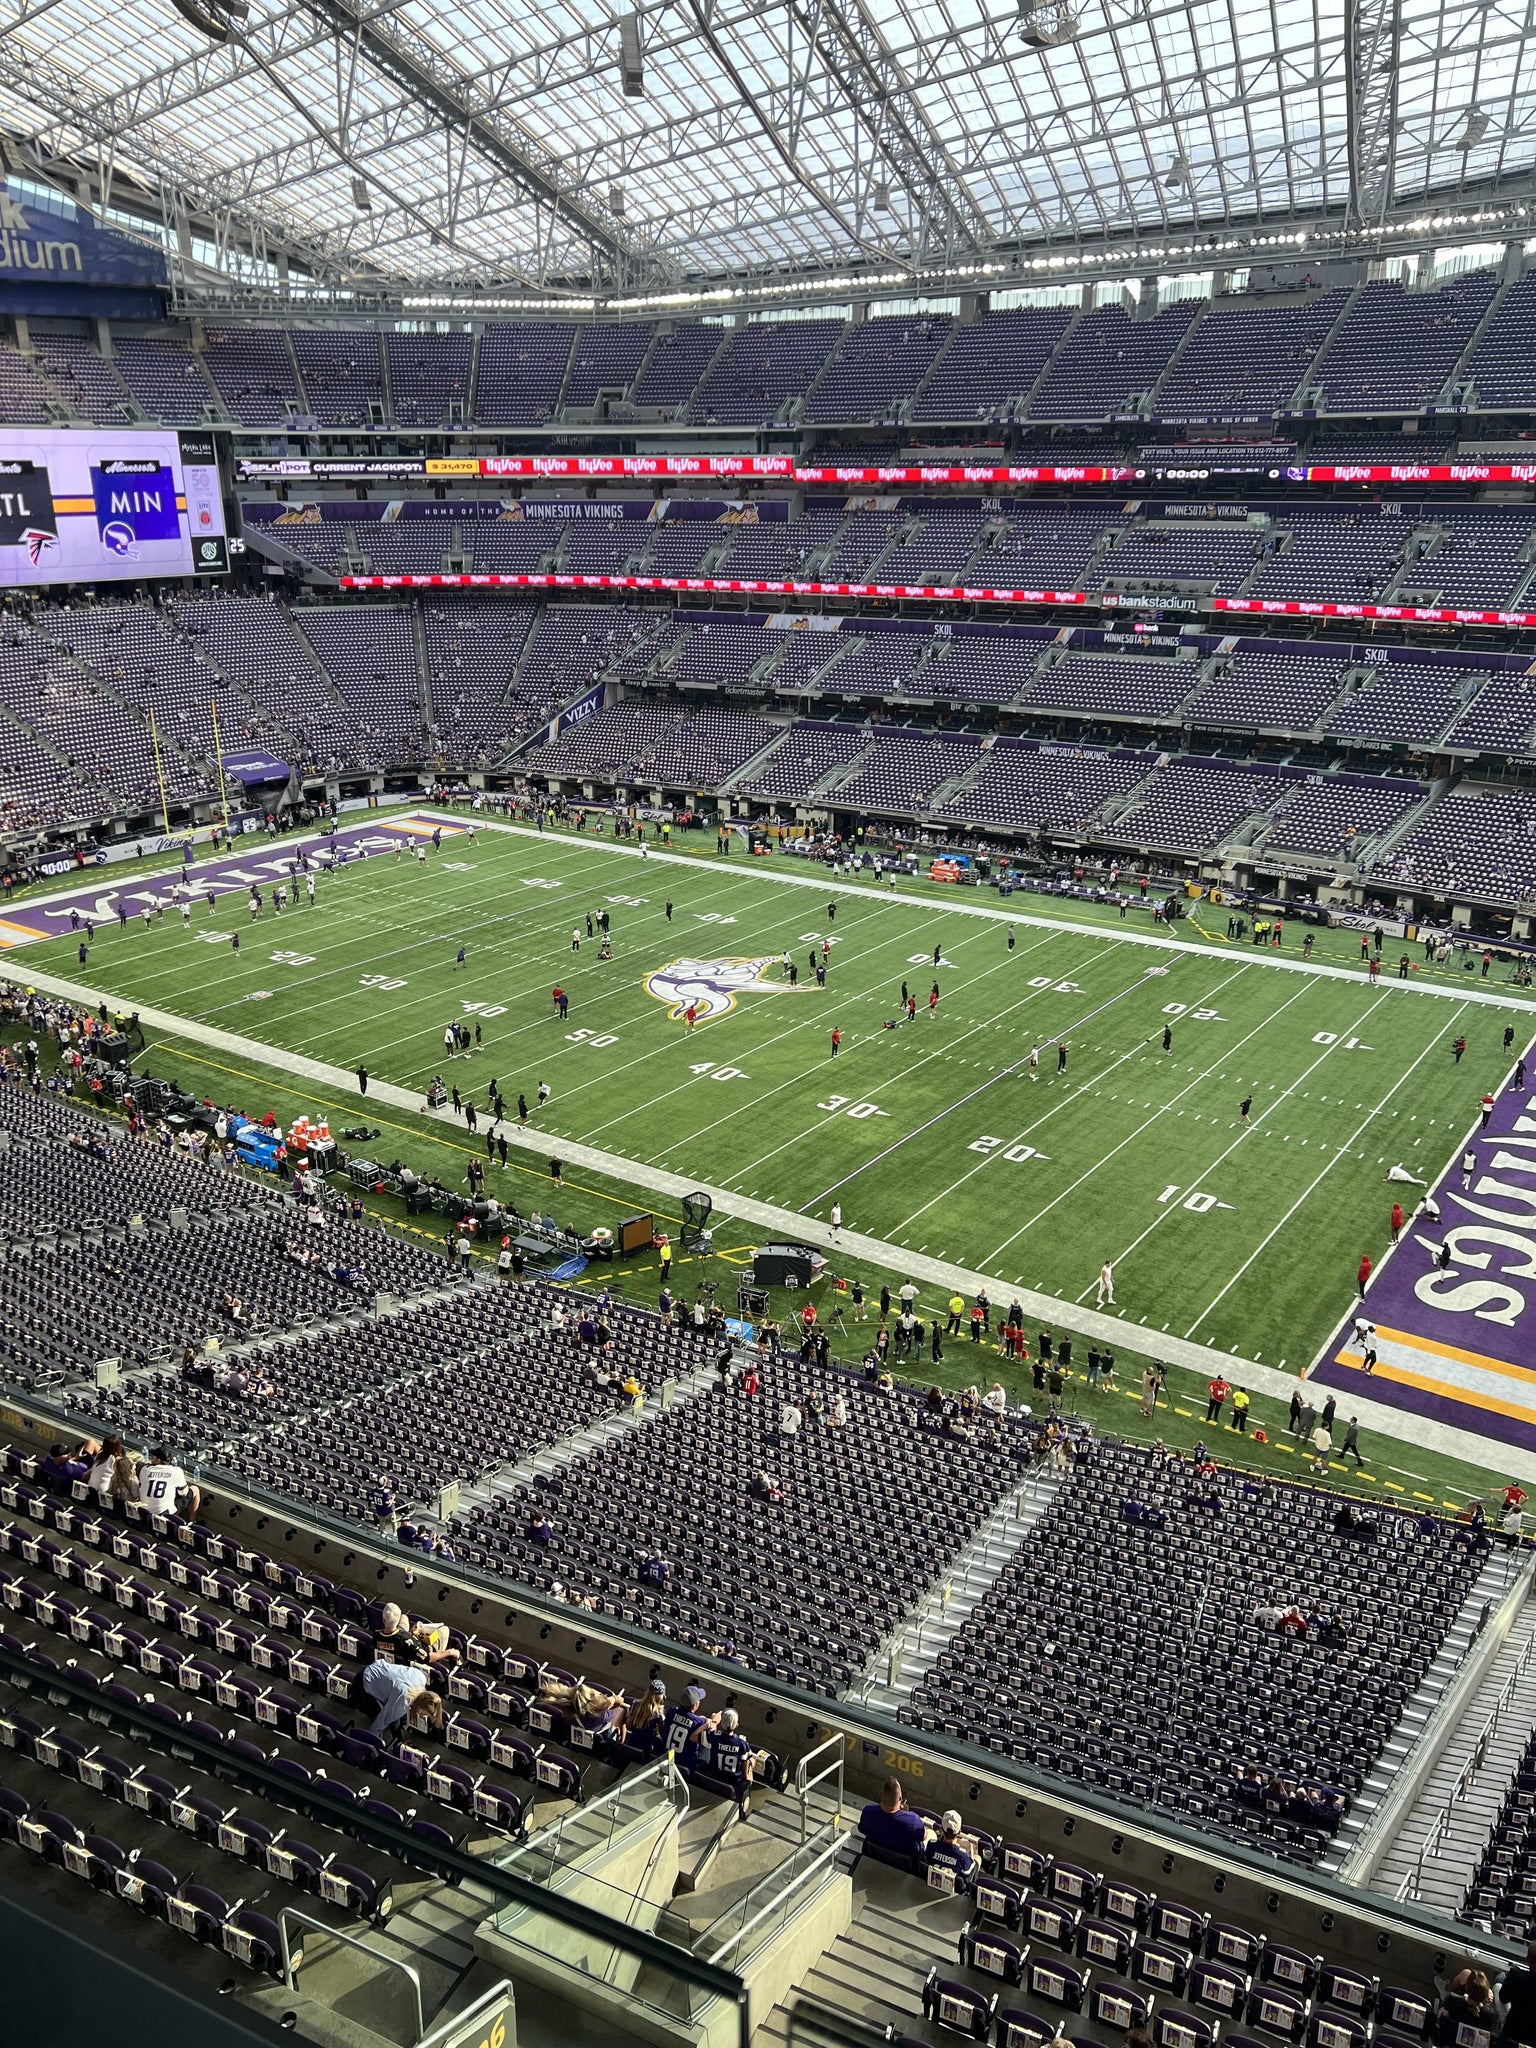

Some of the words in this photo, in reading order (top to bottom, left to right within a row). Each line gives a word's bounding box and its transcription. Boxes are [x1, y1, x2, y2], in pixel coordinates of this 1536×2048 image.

[250, 463, 281, 472] SPLIT
[287, 464, 308, 472] POT
[313, 463, 366, 472] CURRENT
[367, 463, 423, 472] JACKPOT:
[486, 458, 522, 474] HyVee
[533, 458, 568, 474] HyVee
[578, 458, 614, 474] HyVee
[624, 458, 657, 474] HyVee
[667, 458, 700, 474] HyVee
[710, 458, 743, 474] HyVee
[753, 458, 787, 474] HyVee
[1334, 467, 1371, 481] HyVee
[1391, 467, 1430, 481] HyVee
[1451, 466, 1490, 480] HyVee
[1135, 470, 1146, 479] 0
[1166, 469, 1209, 479] 90:00
[1269, 469, 1280, 479] 0
[0, 493, 32, 517] TL
[111, 491, 162, 514] MIN
[981, 498, 1002, 510] SKOL
[1380, 503, 1403, 515] SKOL
[425, 508, 453, 516] HOME
[461, 508, 474, 516] OF
[481, 508, 501, 516] THE
[526, 504, 582, 519] MINNESOTA
[584, 504, 624, 519] VIKINGS
[1165, 505, 1207, 517] MINNESOTA
[1217, 505, 1249, 517] VIKINGS
[230, 539, 245, 552] 25
[934, 624, 954, 636] SKOL
[1104, 632, 1142, 644] MINNESOTA
[1151, 635, 1180, 647] VIKINGS
[1364, 648, 1390, 662] SKOL
[625, 679, 641, 687] sleep
[725, 686, 766, 697] ticketmaster
[565, 697, 597, 724] VIZZY
[1222, 727, 1256, 736] ORTHOPEDICS
[1336, 738, 1353, 746] LAND
[1362, 741, 1380, 750] LAKES
[1039, 745, 1075, 758] MINNESOTA
[1083, 749, 1110, 760] VIKINGS
[1514, 758, 1536, 766] PENTA
[1307, 774, 1324, 785] SKOL
[243, 818, 257, 832] 25
[41, 859, 71, 875] 90:00
[1254, 867, 1281, 877] MINNESOTA
[1287, 871, 1308, 882] VIKINGS
[1340, 916, 1376, 932] Skol
[798, 932, 843, 945] 50
[270, 951, 317, 966] 20
[359, 974, 409, 991] 30
[1026, 976, 1080, 993] 30
[462, 1001, 509, 1018] 40
[1161, 1002, 1219, 1021] 20
[563, 1029, 621, 1048] 50
[1310, 1031, 1360, 1050] 10
[687, 1062, 744, 1082] 40
[816, 1095, 881, 1119] 30
[966, 1135, 1037, 1163] 20
[1156, 1184, 1218, 1213] 10
[1, 1412, 24, 1429] 208
[36, 1427, 57, 1441] 207
[1078, 1443, 1089, 1453] 18
[148, 1471, 172, 1479] JEFFERSON
[147, 1480, 168, 1499] 18
[674, 1713, 693, 1728] THIELEN
[665, 1724, 689, 1752] 19
[820, 1727, 856, 1751] 27
[718, 1743, 740, 1753] THIELEN
[716, 1753, 738, 1773] 19
[884, 1750, 924, 1778] 206
[932, 1852, 957, 1867] JEFFERSON
